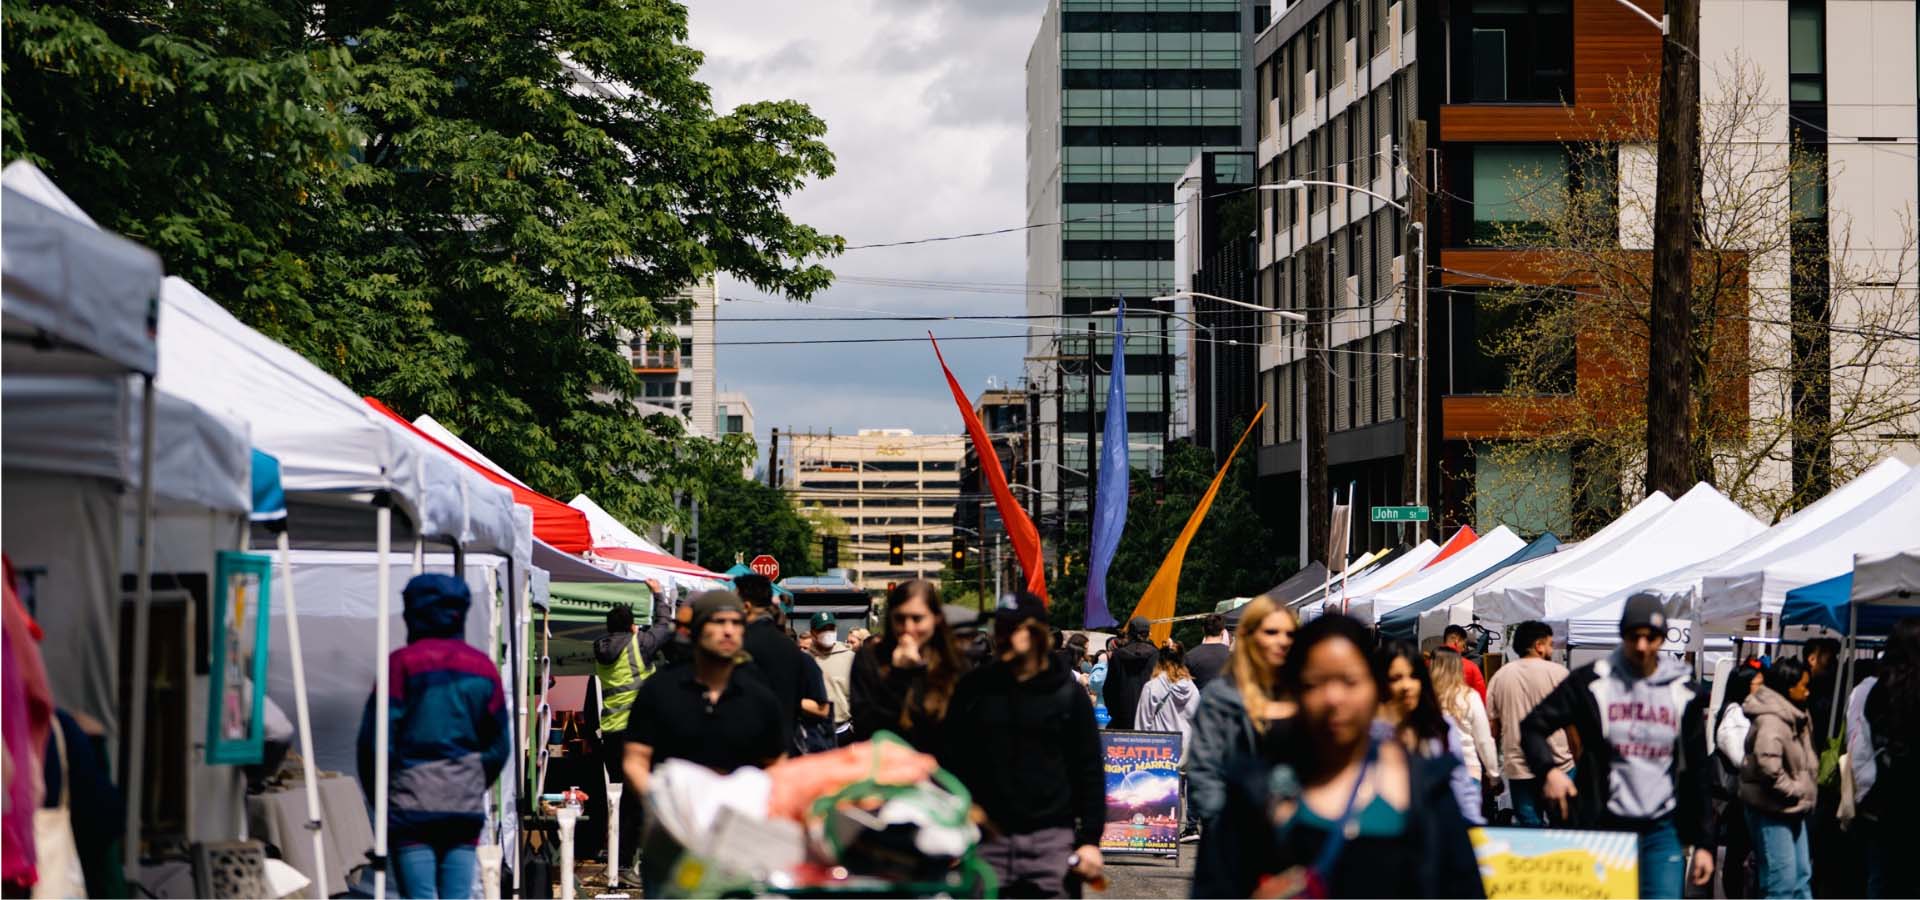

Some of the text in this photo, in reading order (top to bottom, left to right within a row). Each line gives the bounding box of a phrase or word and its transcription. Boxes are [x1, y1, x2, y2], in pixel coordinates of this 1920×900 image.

[1375, 508, 1417, 519] John St
[752, 564, 777, 576] STOP
[1107, 746, 1173, 758] SEATTLE
[1135, 760, 1177, 772] MARKET
[1506, 858, 1583, 875] SOUTH
[1489, 877, 1530, 897] AKE
